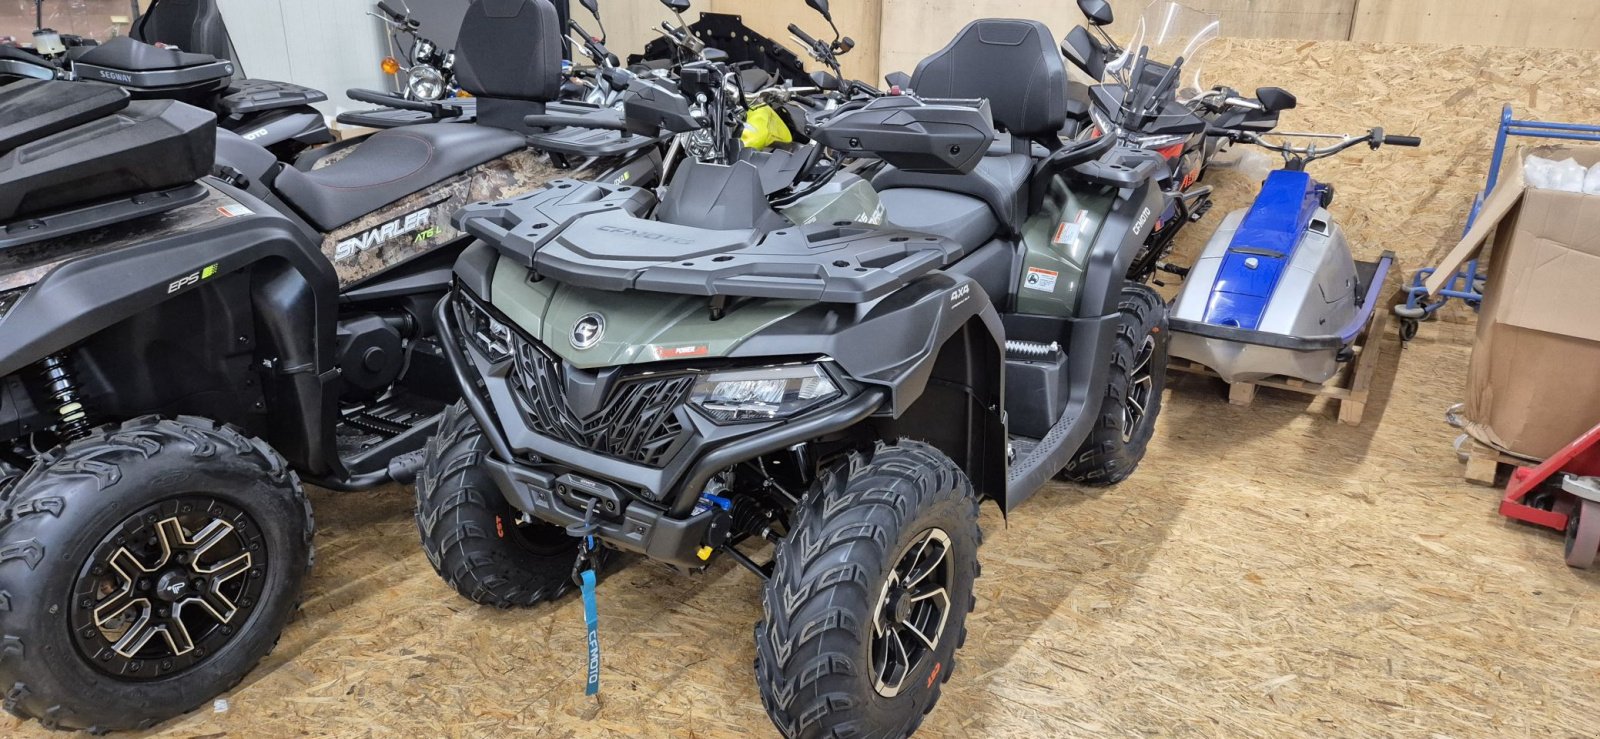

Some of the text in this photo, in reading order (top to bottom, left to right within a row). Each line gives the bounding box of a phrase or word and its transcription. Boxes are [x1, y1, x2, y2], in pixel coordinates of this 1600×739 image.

[100, 70, 132, 83] SEGWAY
[1132, 206, 1151, 236] CFMOTO
[334, 208, 431, 263] SNARLER
[167, 271, 200, 294] EPS
[950, 284, 970, 301] 4X4
[588, 629, 599, 684] CFMOTO
